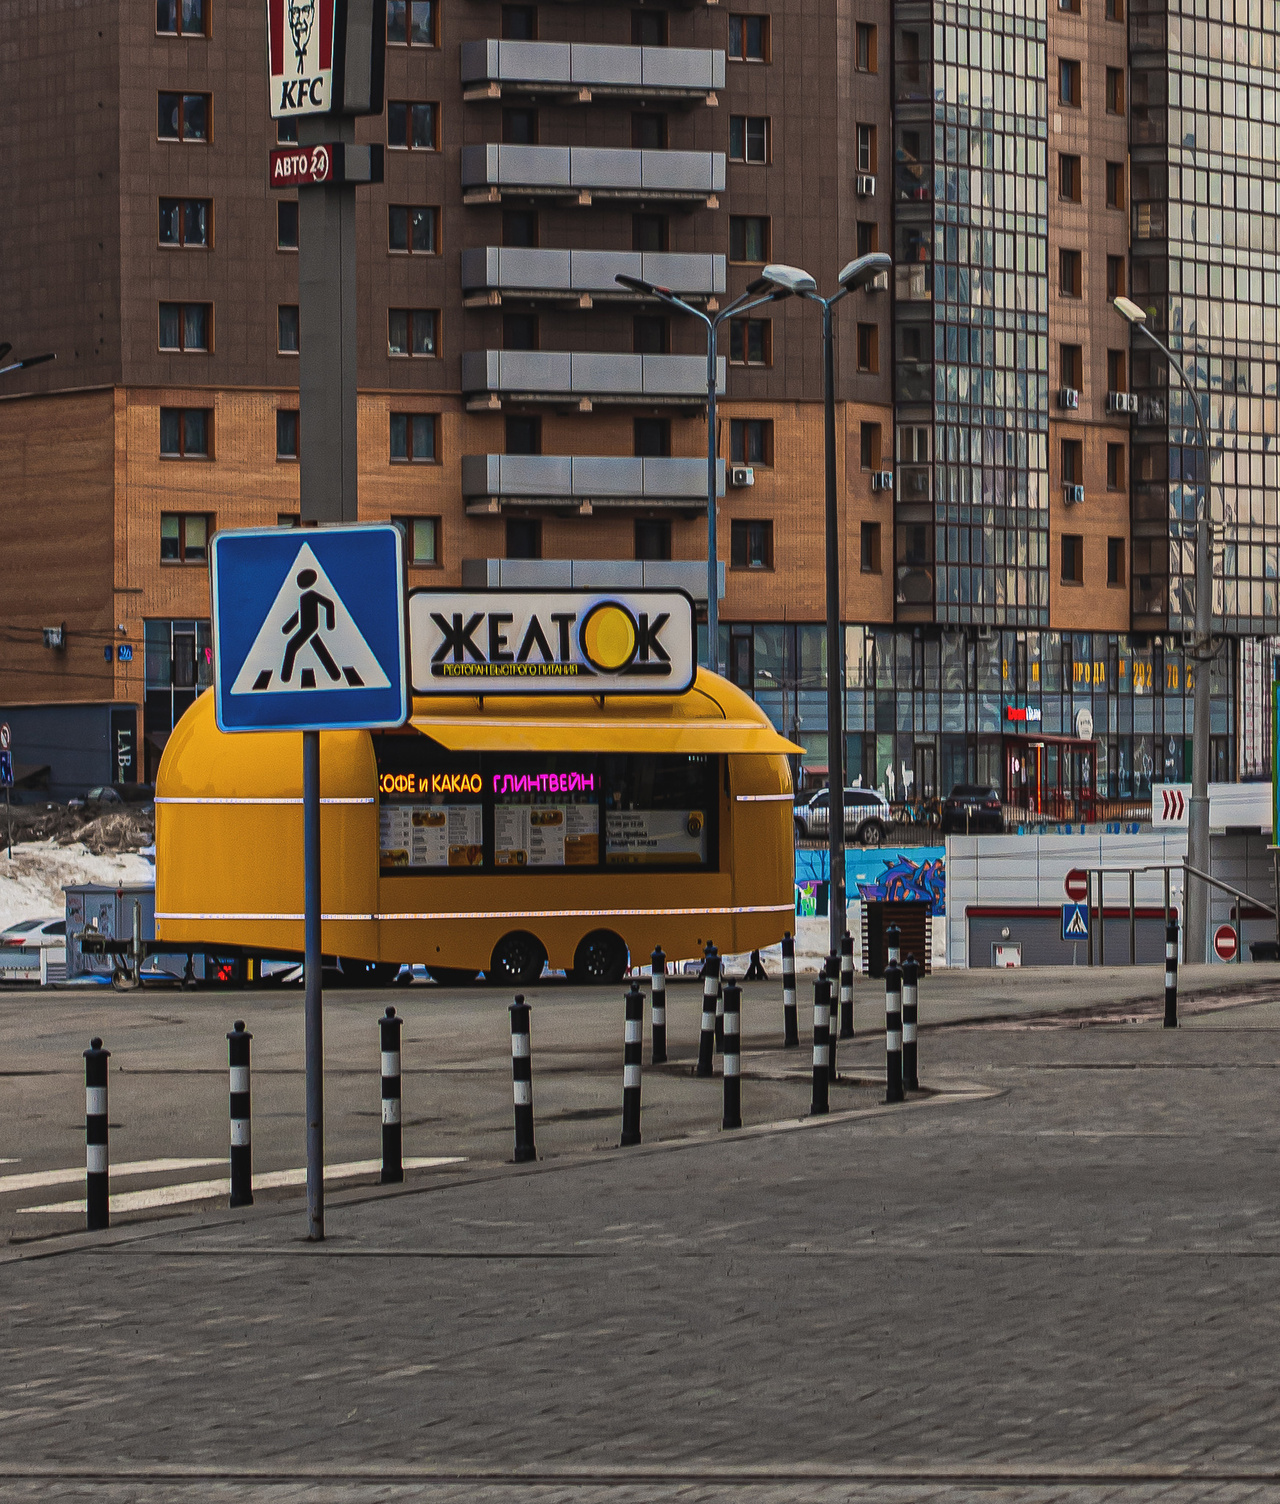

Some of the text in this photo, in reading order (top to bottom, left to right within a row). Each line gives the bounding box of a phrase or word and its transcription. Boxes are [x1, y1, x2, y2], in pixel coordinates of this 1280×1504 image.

[280, 77, 323, 110] KFC
[274, 153, 325, 178] АВТО 24
[429, 600, 672, 674] ЖЕЛТОК
[443, 663, 578, 676] РЕСТОРАН БЫСТРОГО ПИТАНИЯ
[117, 729, 132, 767] LAB
[432, 773, 482, 794] КАКАО
[493, 772, 594, 794] ГЛИНТВЕЙН
